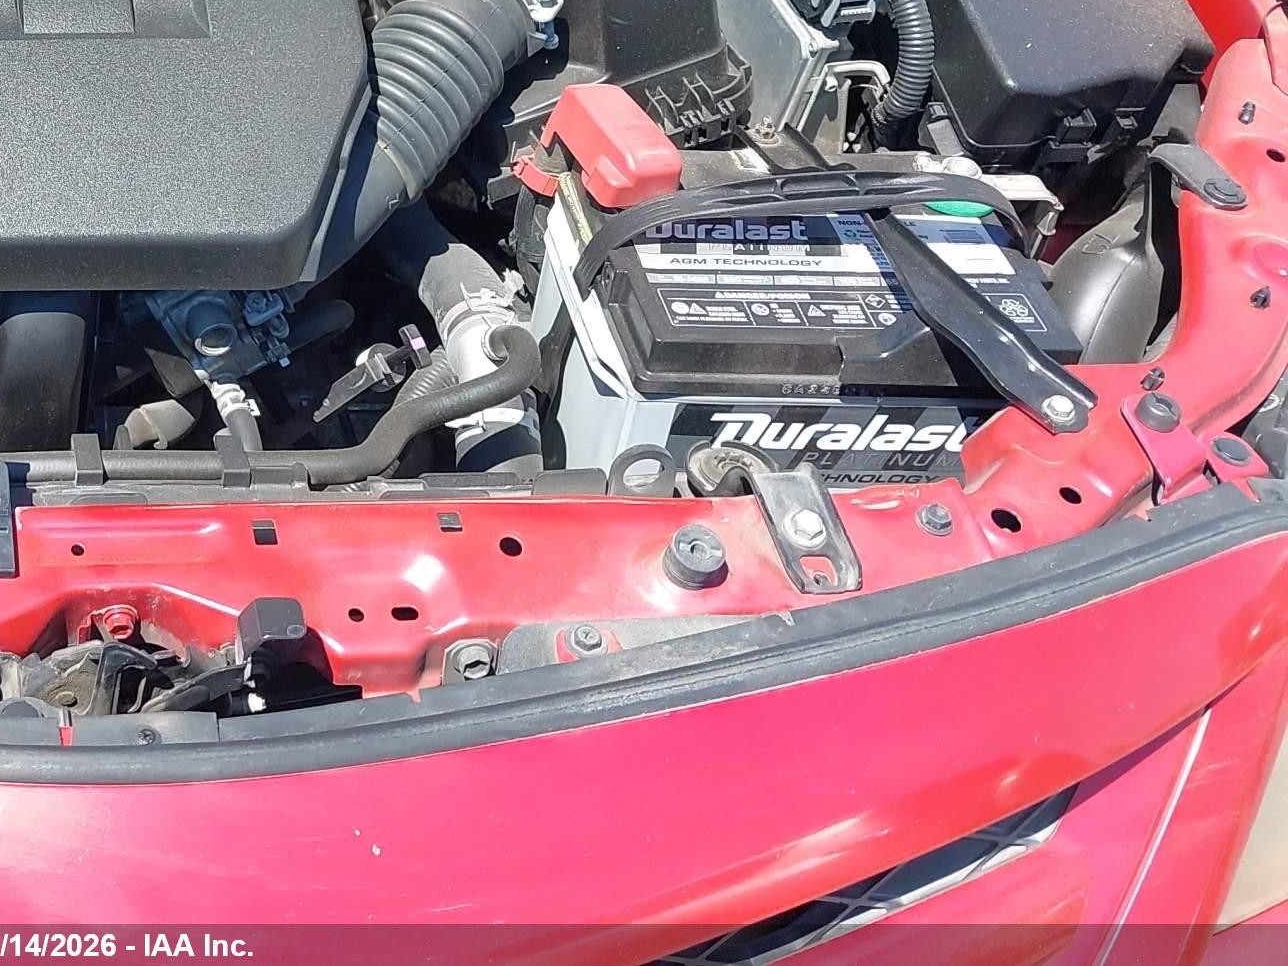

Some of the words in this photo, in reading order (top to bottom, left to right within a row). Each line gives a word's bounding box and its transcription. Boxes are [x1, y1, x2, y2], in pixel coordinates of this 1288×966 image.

[645, 219, 809, 241] Duralast
[708, 243, 811, 252] PLATINUM
[669, 257, 708, 265] AGM
[714, 258, 823, 267] TECHNOLOGY
[710, 412, 979, 452] Duralast
[800, 452, 959, 467] PLATINUM
[821, 473, 941, 485] HNOLOGY
